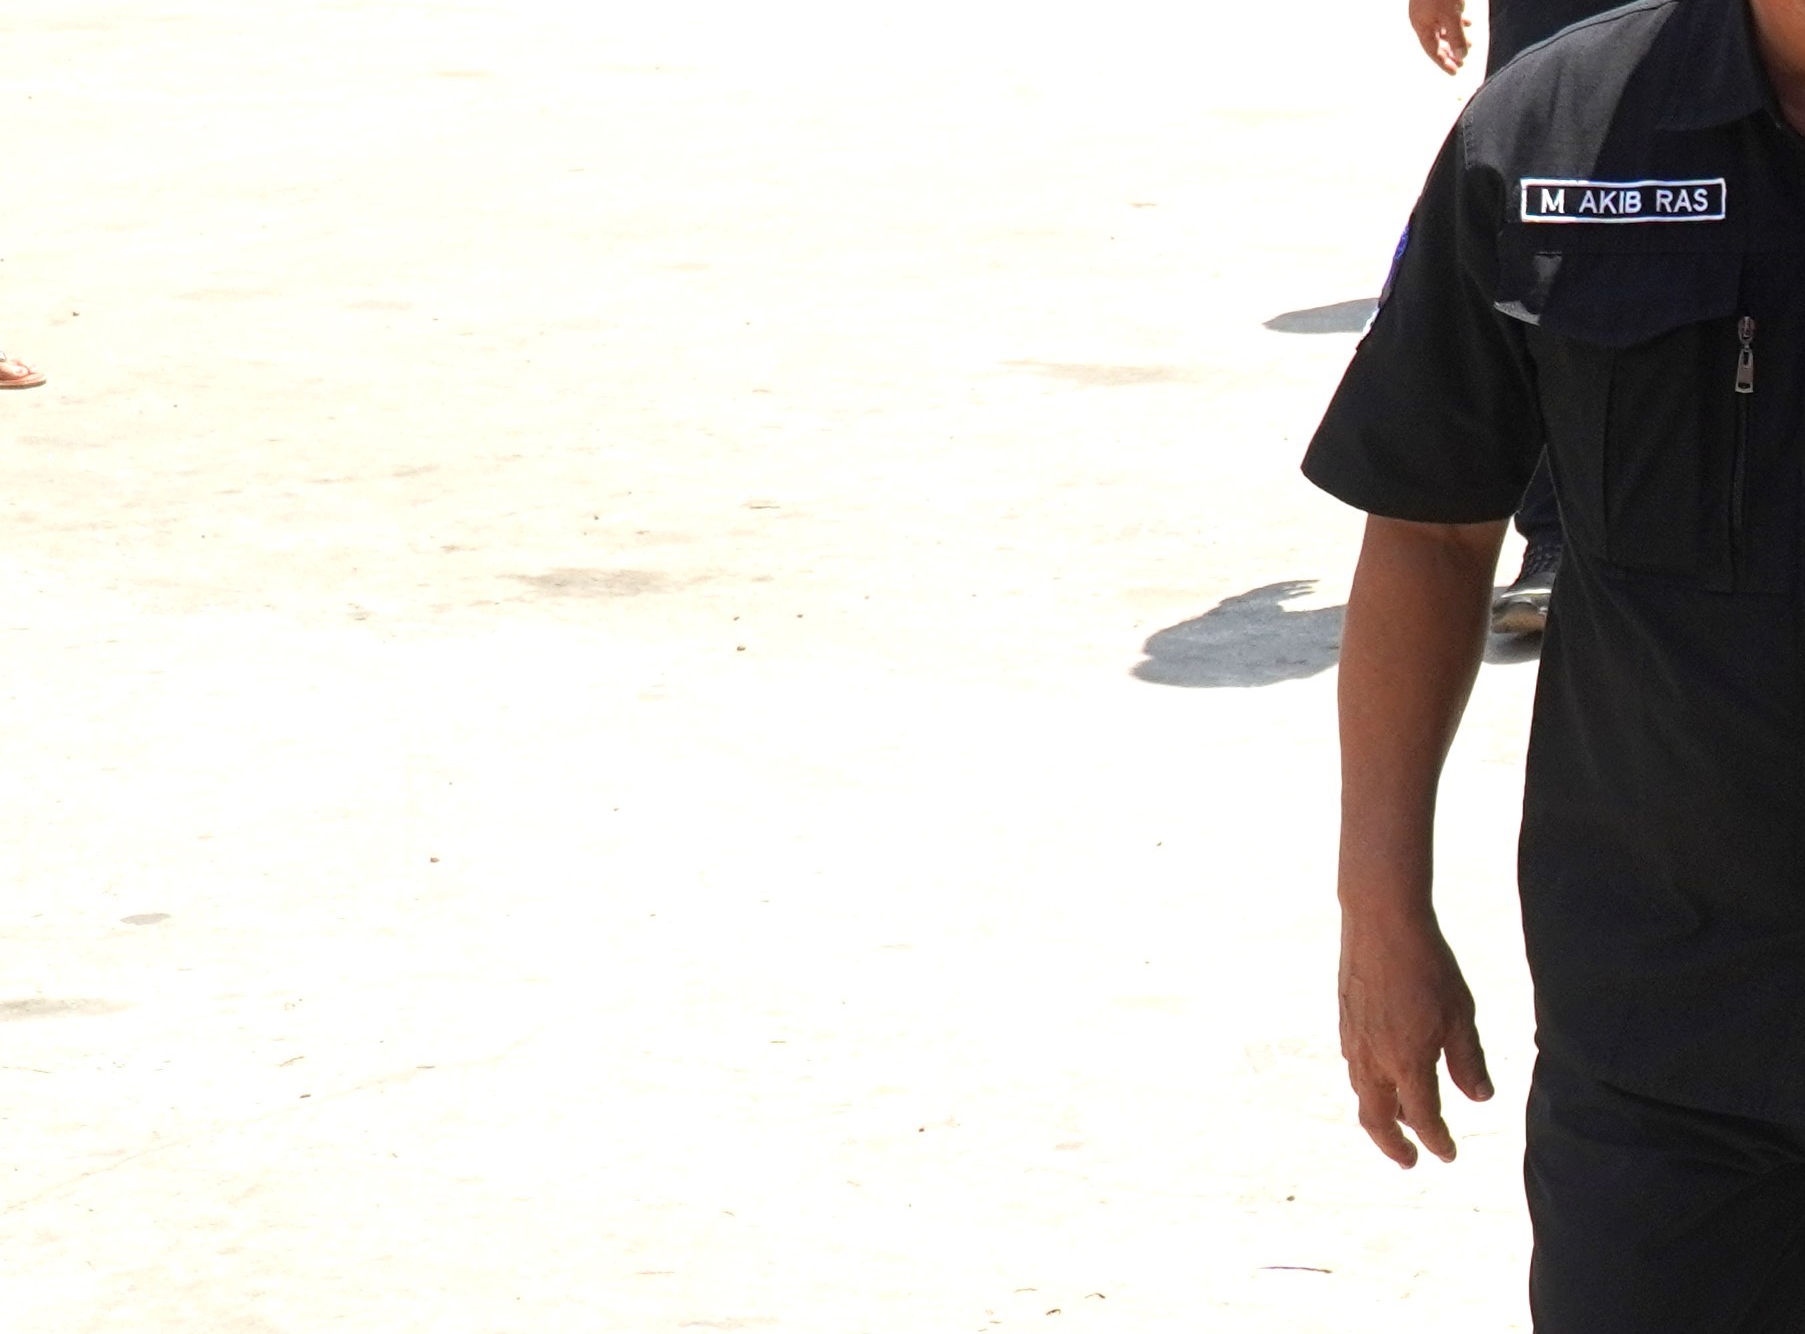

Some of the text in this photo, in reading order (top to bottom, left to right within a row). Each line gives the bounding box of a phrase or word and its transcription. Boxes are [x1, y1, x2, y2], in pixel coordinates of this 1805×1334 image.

[1540, 188, 1709, 215] M AKIB RAS
